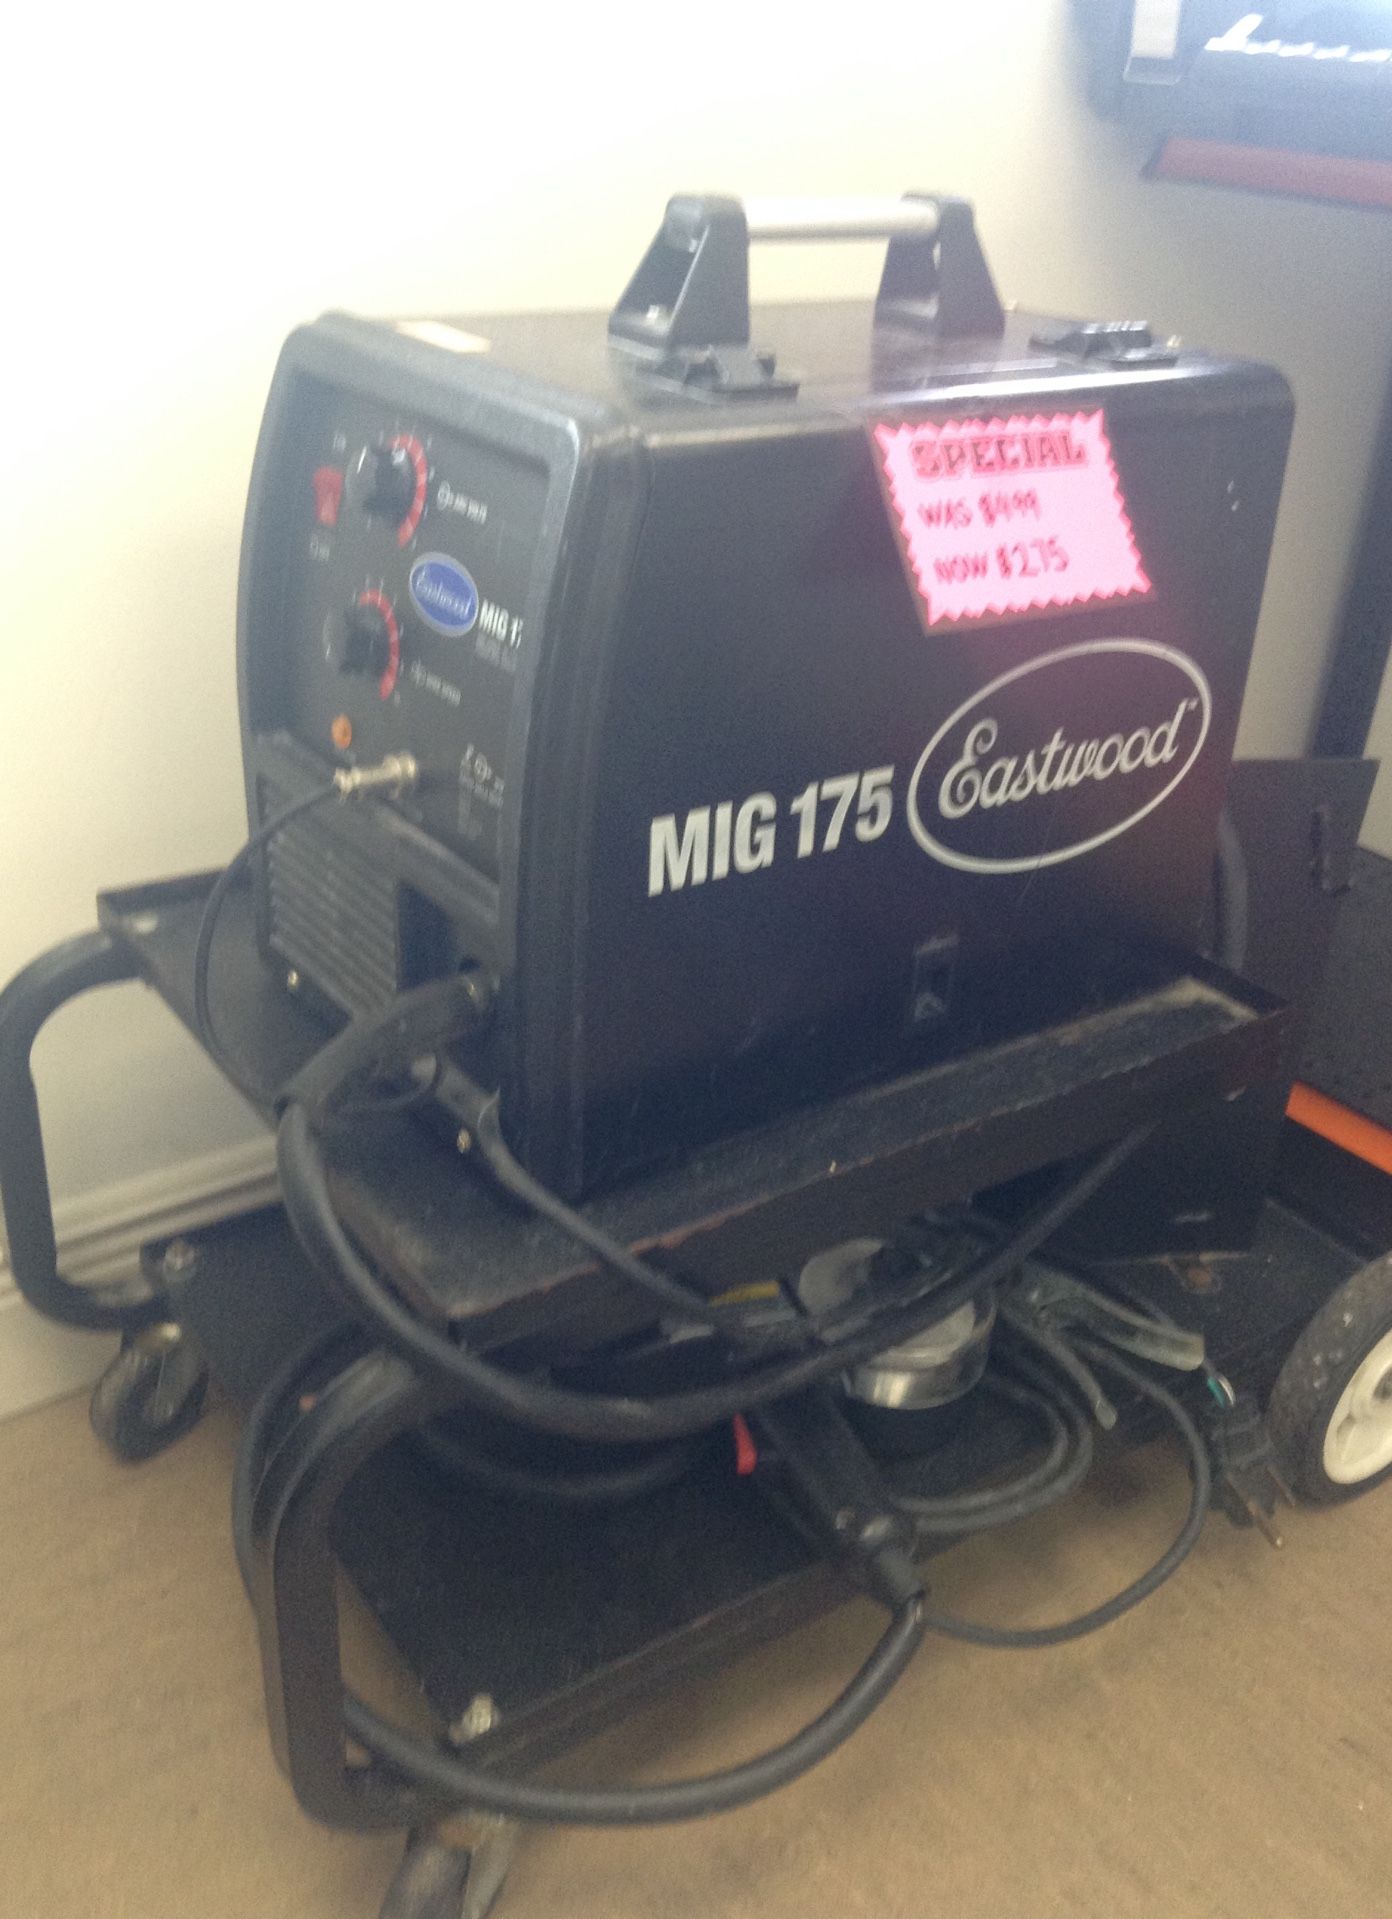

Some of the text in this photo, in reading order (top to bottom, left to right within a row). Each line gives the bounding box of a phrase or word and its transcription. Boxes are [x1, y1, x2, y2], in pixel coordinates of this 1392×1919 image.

[910, 430, 1088, 481] SPECIAL
[918, 498, 973, 530] WAS
[933, 535, 1070, 585] NOW $275
[937, 697, 1194, 820] Eastwood
[648, 764, 895, 897] MIG 175
